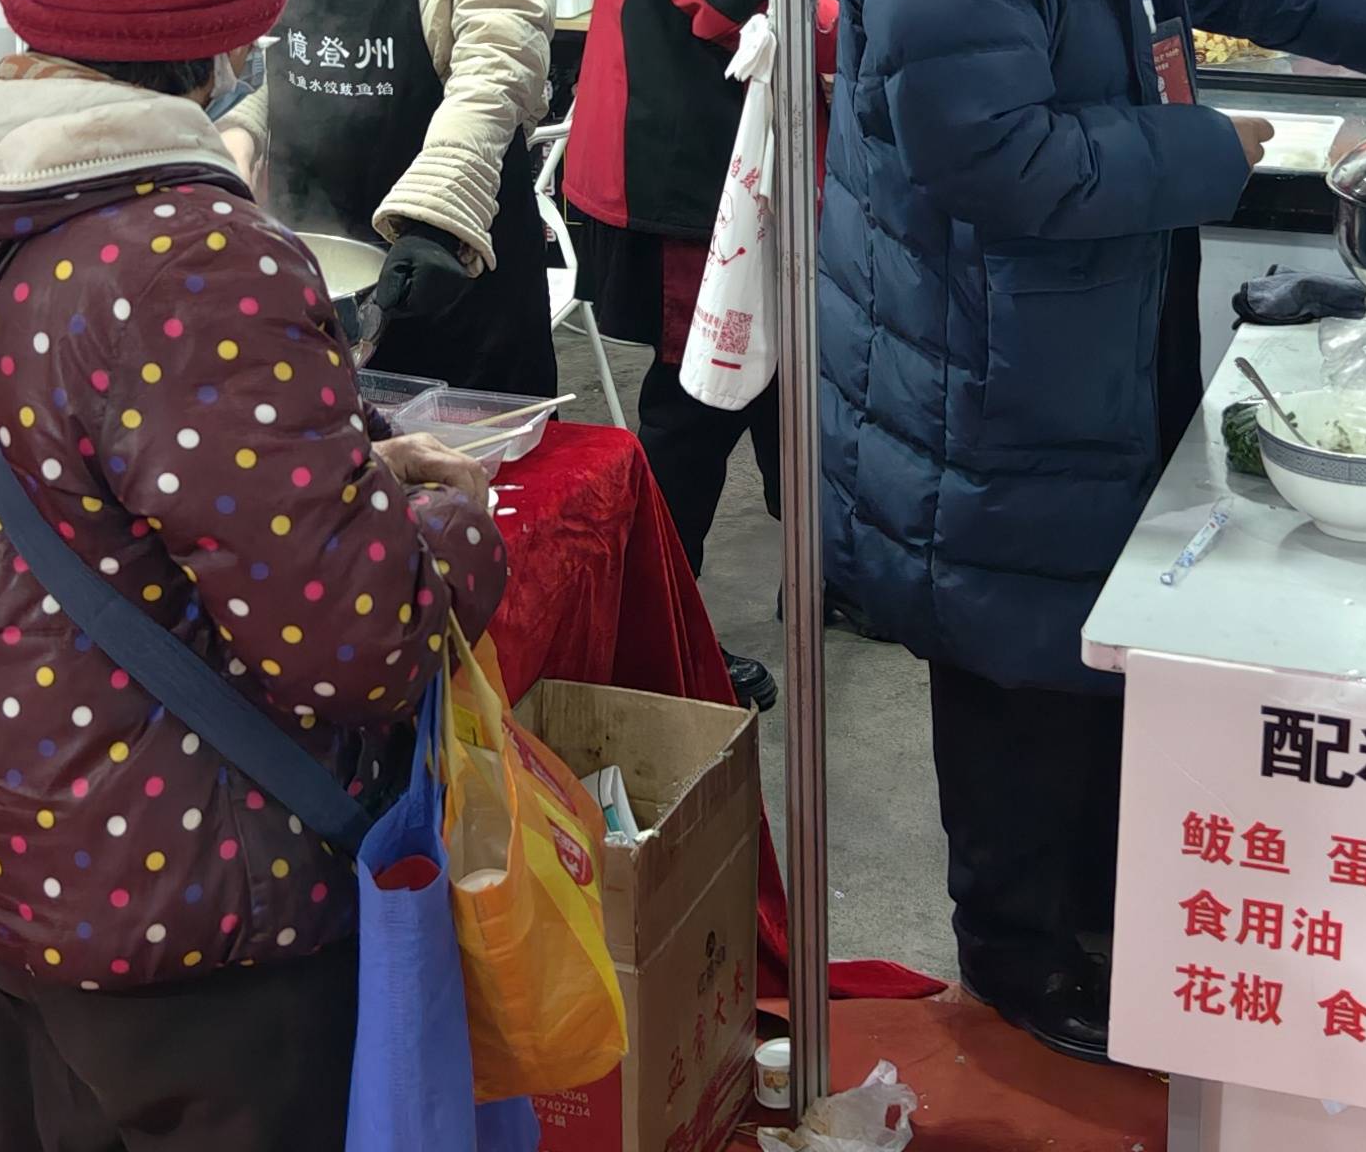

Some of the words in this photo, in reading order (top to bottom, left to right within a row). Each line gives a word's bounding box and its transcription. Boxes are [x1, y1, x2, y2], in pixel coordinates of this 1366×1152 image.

[1180, 810, 1292, 876] 鲅鱼
[1178, 888, 1345, 962] 食用油
[1173, 962, 1285, 1026] 花椒
